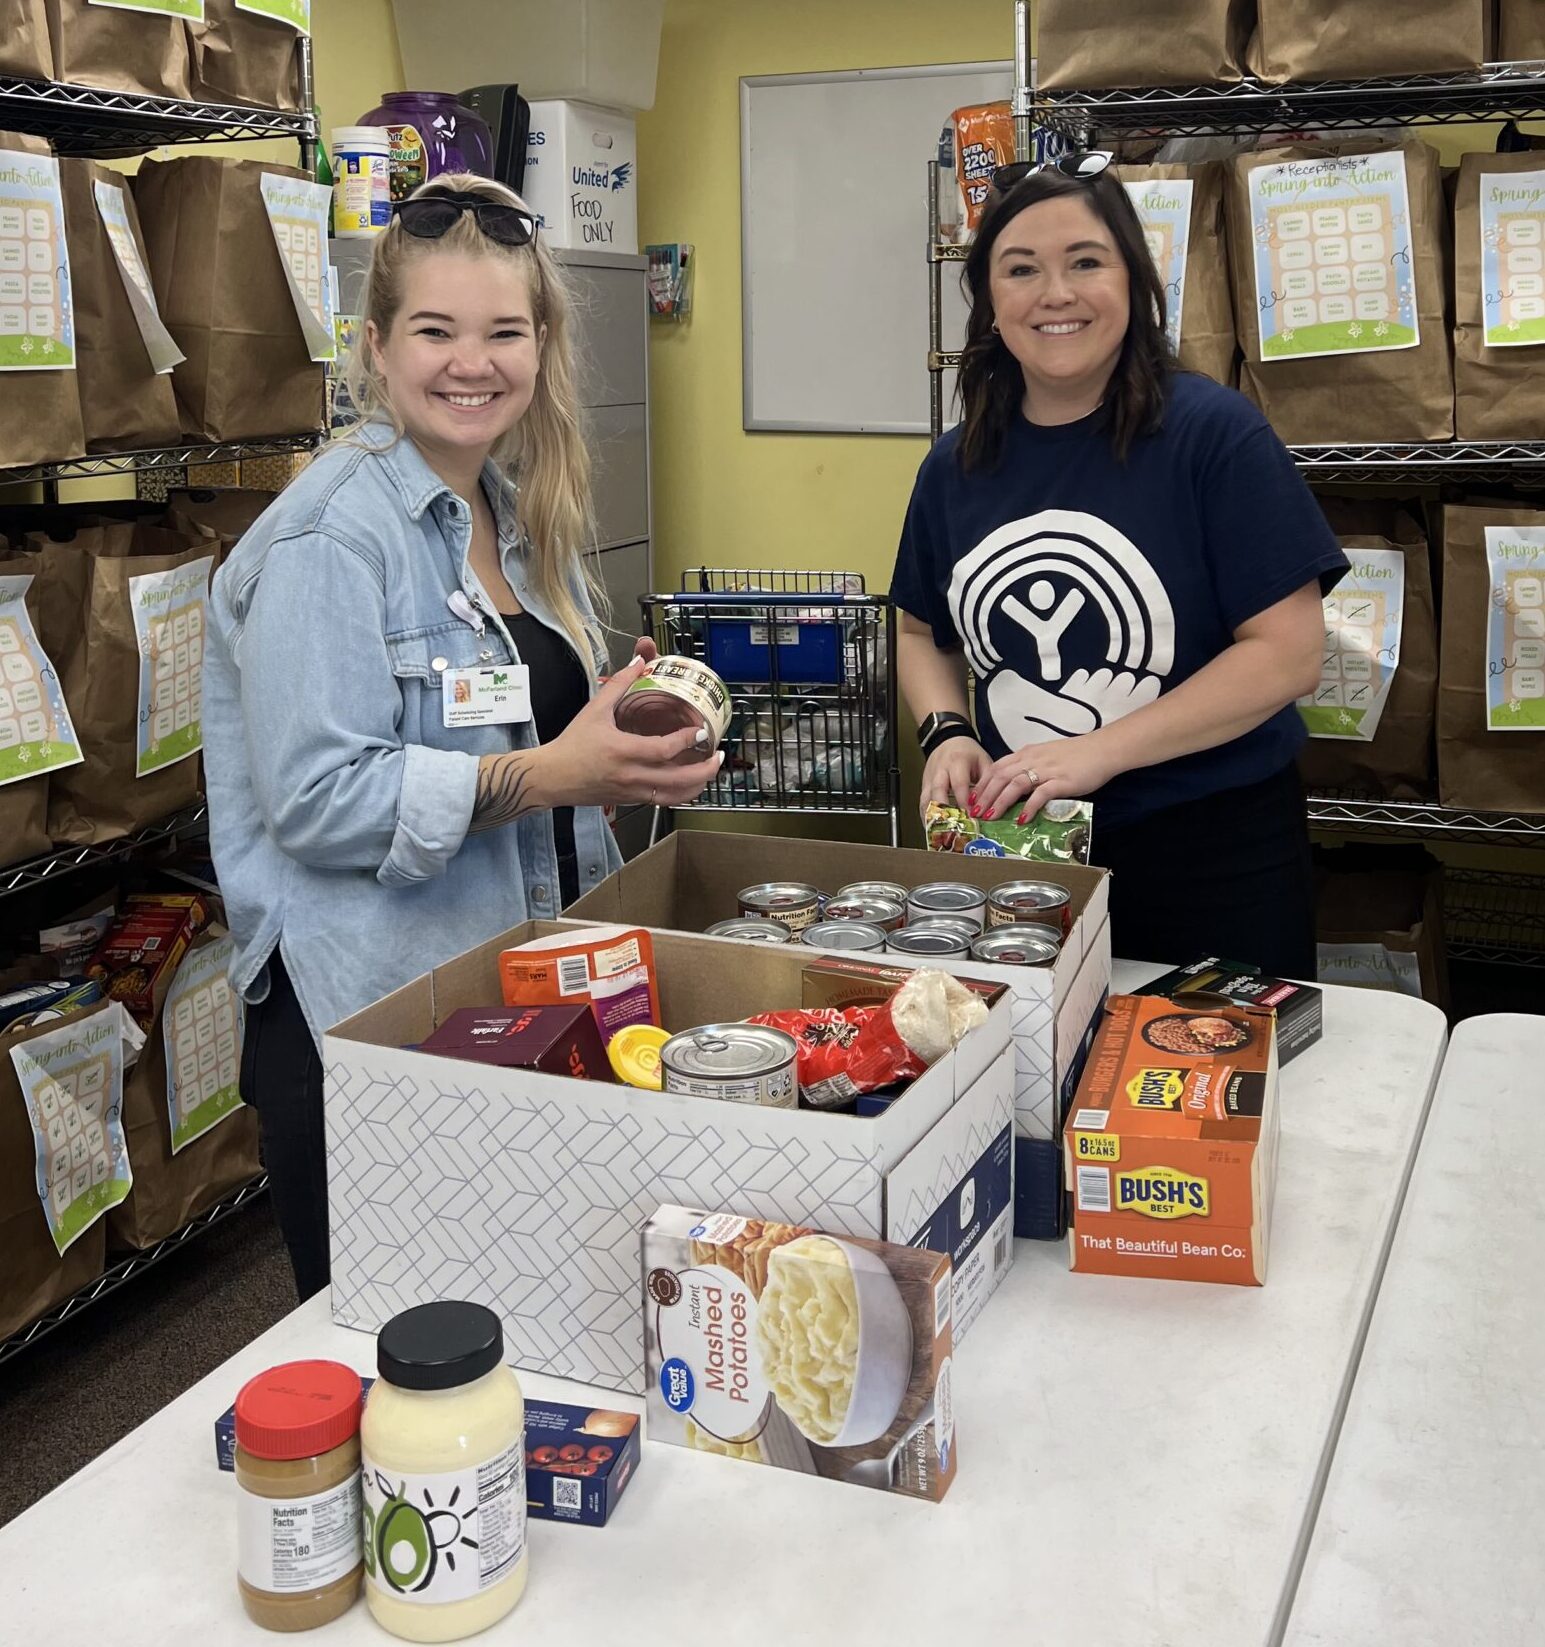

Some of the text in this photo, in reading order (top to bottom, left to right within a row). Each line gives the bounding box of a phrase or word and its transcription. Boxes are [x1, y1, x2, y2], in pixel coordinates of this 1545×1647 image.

[528, 131, 546, 145] ES
[963, 144, 983, 157] OVER
[964, 149, 996, 170] 2200
[573, 166, 609, 188] United
[1288, 158, 1358, 177] Receptionists
[1258, 178, 1308, 198] Spring
[1350, 169, 1395, 185] Action
[571, 192, 602, 220] FOOD
[583, 221, 614, 243] ONLY
[1497, 541, 1539, 560] Spring
[656, 664, 724, 703] CHICKEN BREAST
[494, 694, 507, 702] Erin
[969, 845, 998, 858] Great
[771, 910, 806, 920] Nutrition
[529, 972, 547, 980] MARS
[1108, 1009, 1132, 1032] DOGS
[1103, 1032, 1126, 1049] HOT
[1088, 1057, 1120, 1093] BURGERS
[1137, 1070, 1173, 1106] BUSH'S
[1187, 1072, 1212, 1110] Original
[1229, 1076, 1243, 1110] BAKED BEANS
[1079, 1137, 1089, 1154] 8
[1089, 1146, 1115, 1156] CANS
[1120, 1177, 1205, 1209] BUSH'S
[1150, 1204, 1175, 1214] BEST
[1080, 1235, 1113, 1250] That
[1116, 1237, 1178, 1255] Beautiful
[1181, 1241, 1218, 1257] Bean
[689, 1284, 701, 1329] Instant
[702, 1286, 725, 1392] Mashed
[729, 1292, 749, 1403] Potatoes
[668, 1366, 681, 1407] Great
[678, 1369, 689, 1400] Value
[918, 1464, 927, 1477] WT
[478, 1484, 504, 1501] Calories
[918, 1477, 927, 1491] NET
[273, 1507, 308, 1517] Nutrition
[273, 1518, 294, 1527] Facts
[294, 1545, 310, 1557] 180
